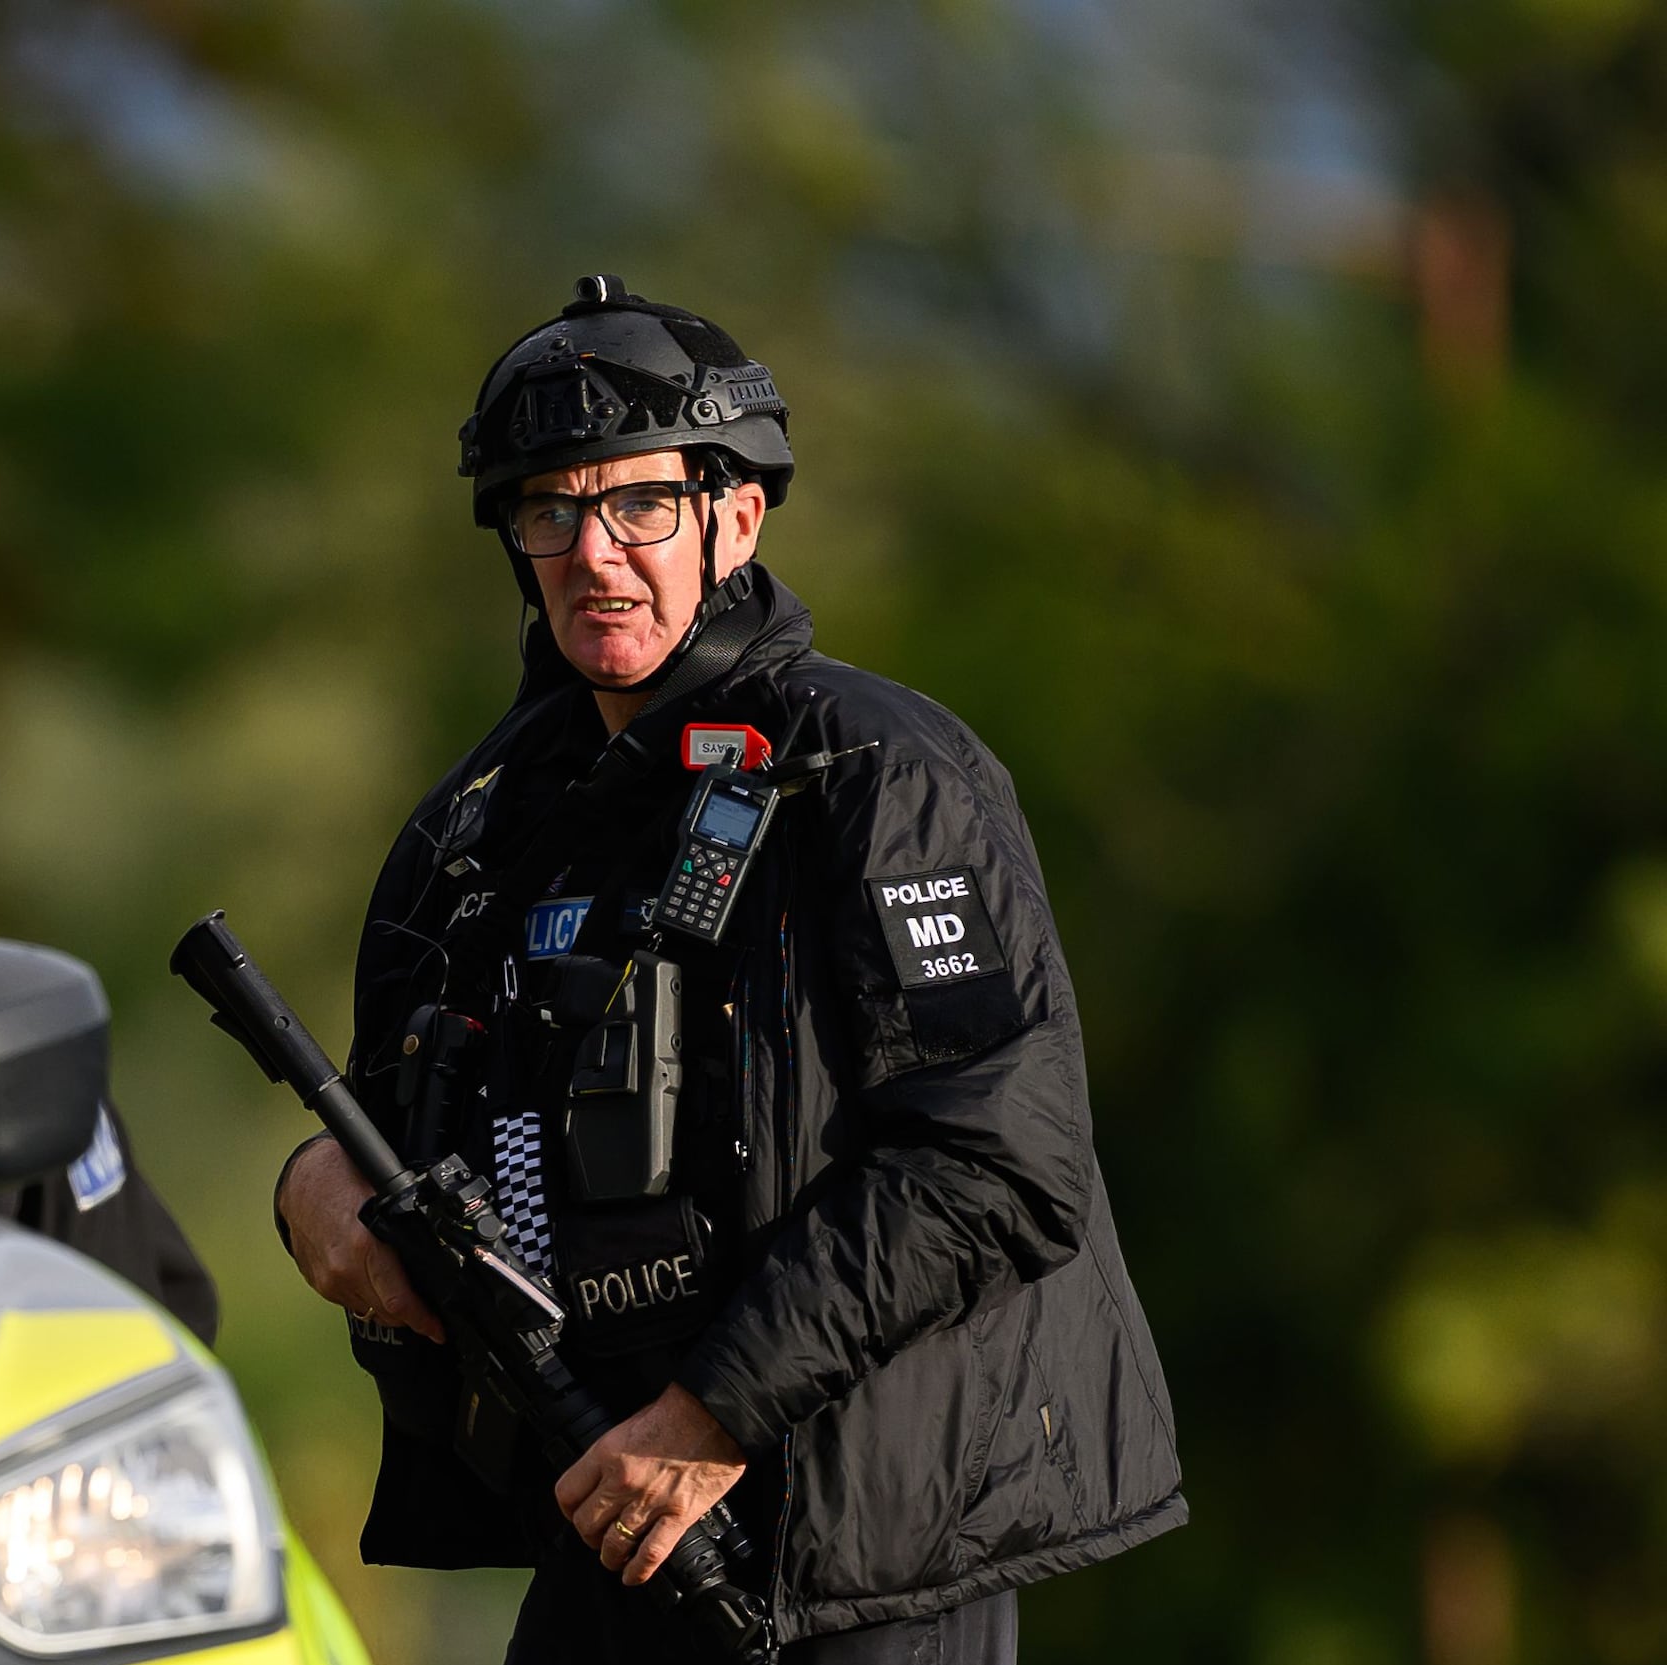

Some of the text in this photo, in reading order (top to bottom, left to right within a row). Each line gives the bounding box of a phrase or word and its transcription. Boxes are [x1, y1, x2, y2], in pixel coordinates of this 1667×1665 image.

[881, 876, 970, 907] POLICE
[905, 913, 966, 948] MD
[921, 952, 980, 979] 3662
[578, 1254, 700, 1320] POLICE
